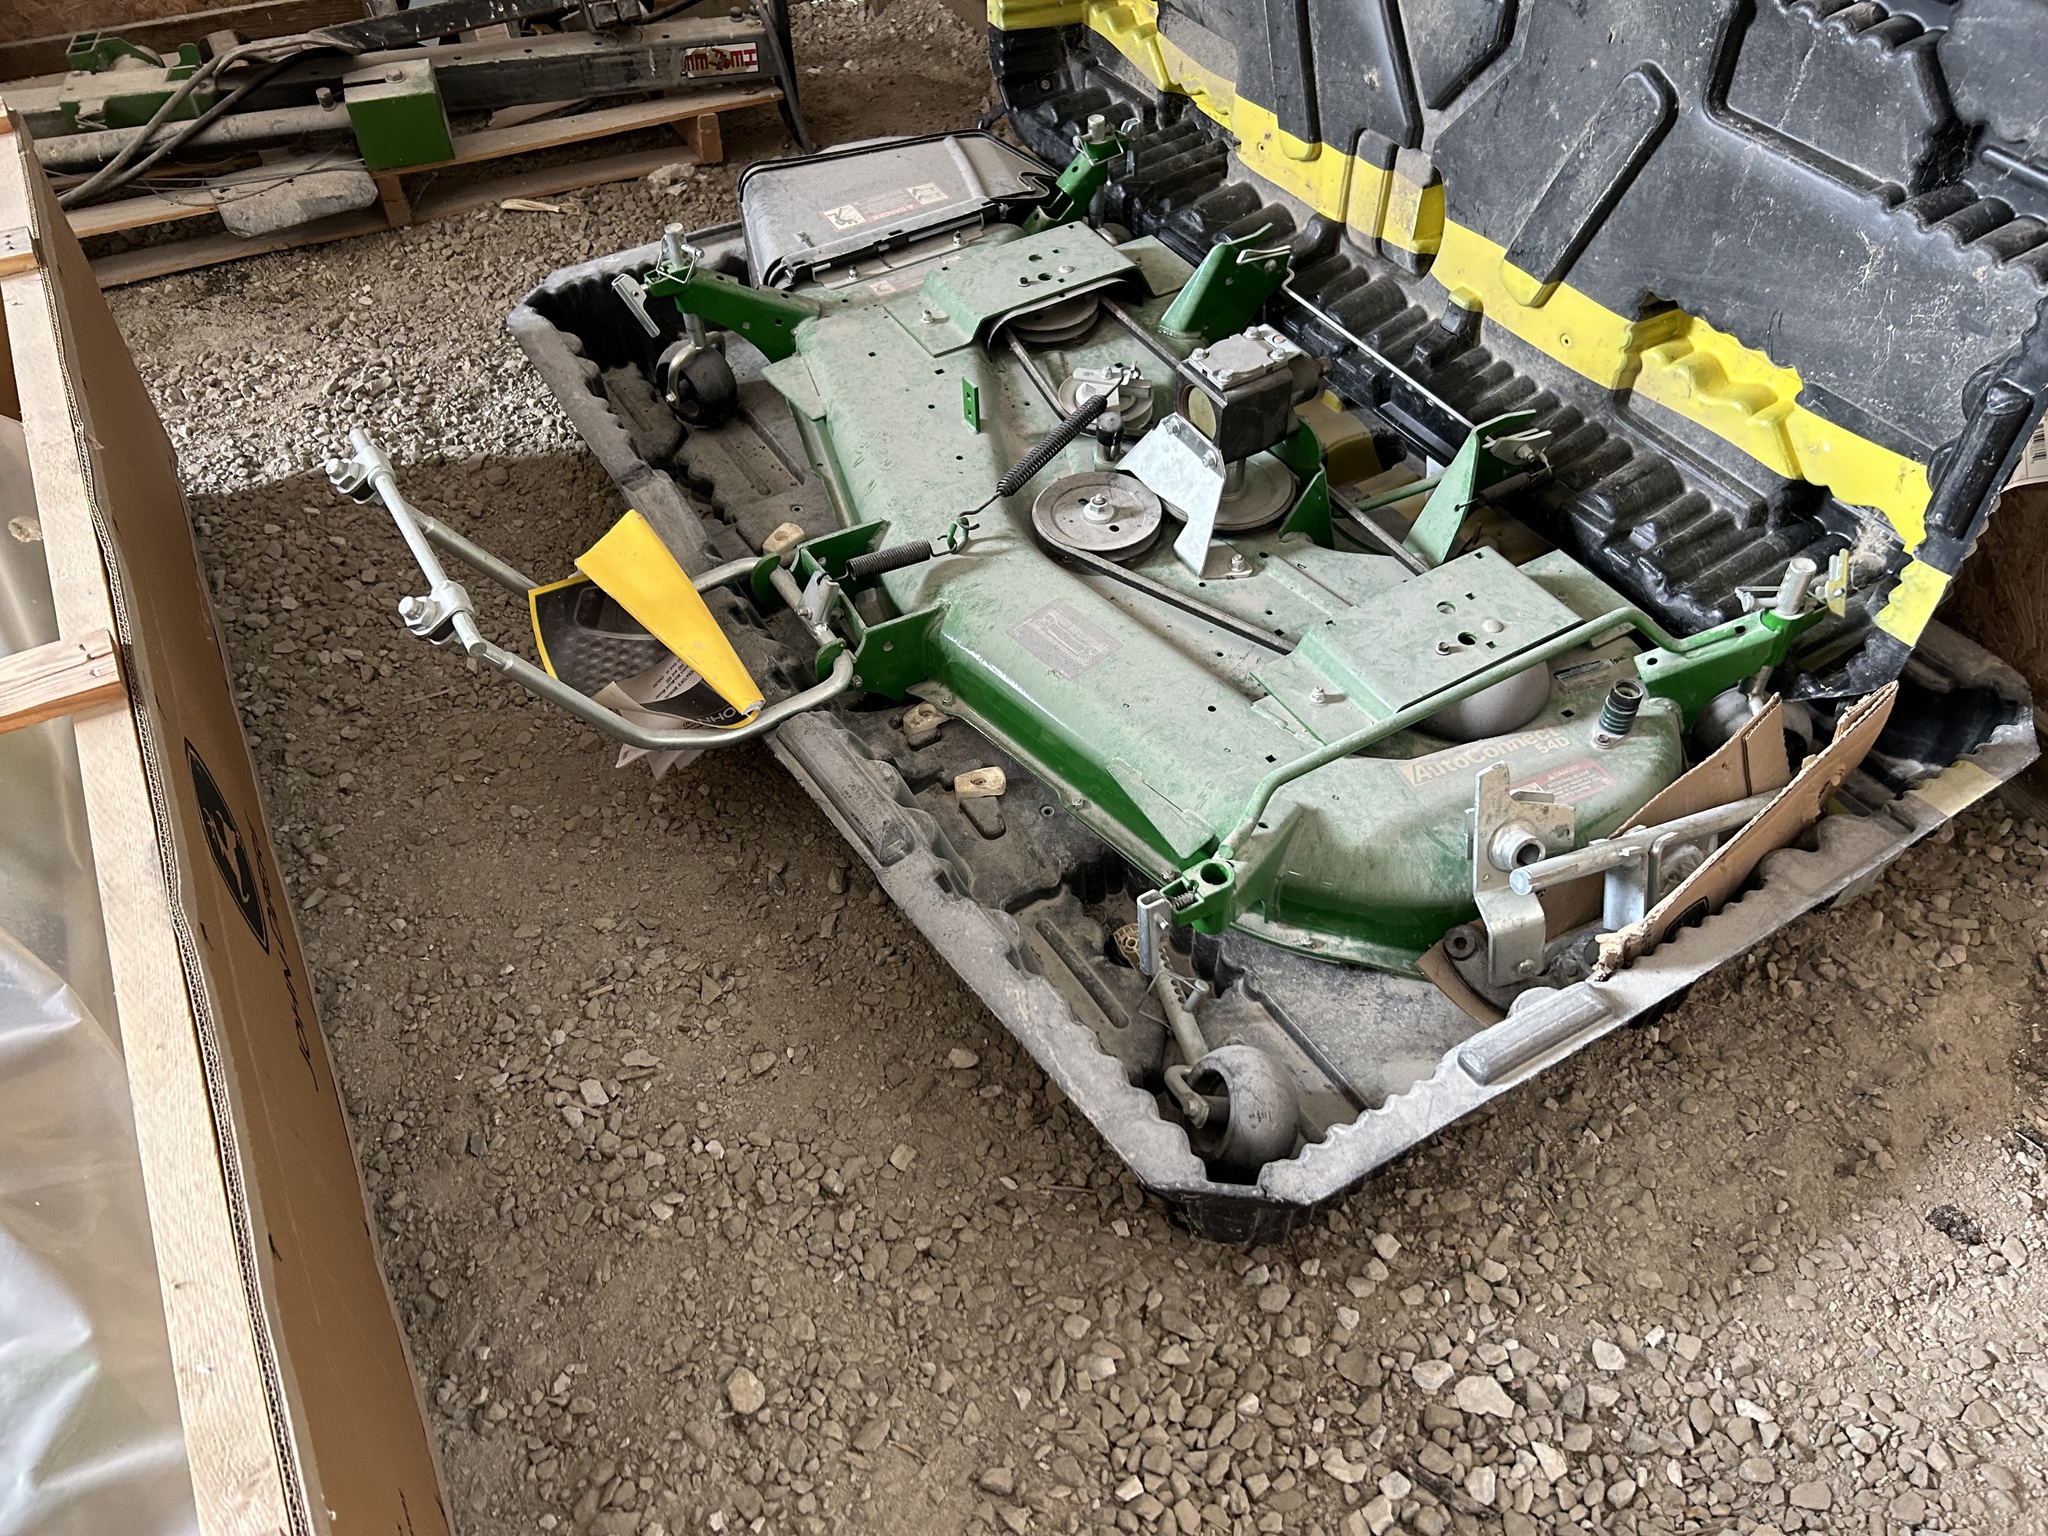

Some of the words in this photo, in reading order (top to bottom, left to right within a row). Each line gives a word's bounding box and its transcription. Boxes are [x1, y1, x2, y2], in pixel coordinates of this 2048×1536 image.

[872, 206, 906, 220] DANGER
[697, 707, 736, 723] OHN
[1535, 736, 1571, 754] 54D
[1416, 728, 1561, 784] AutoConnect
